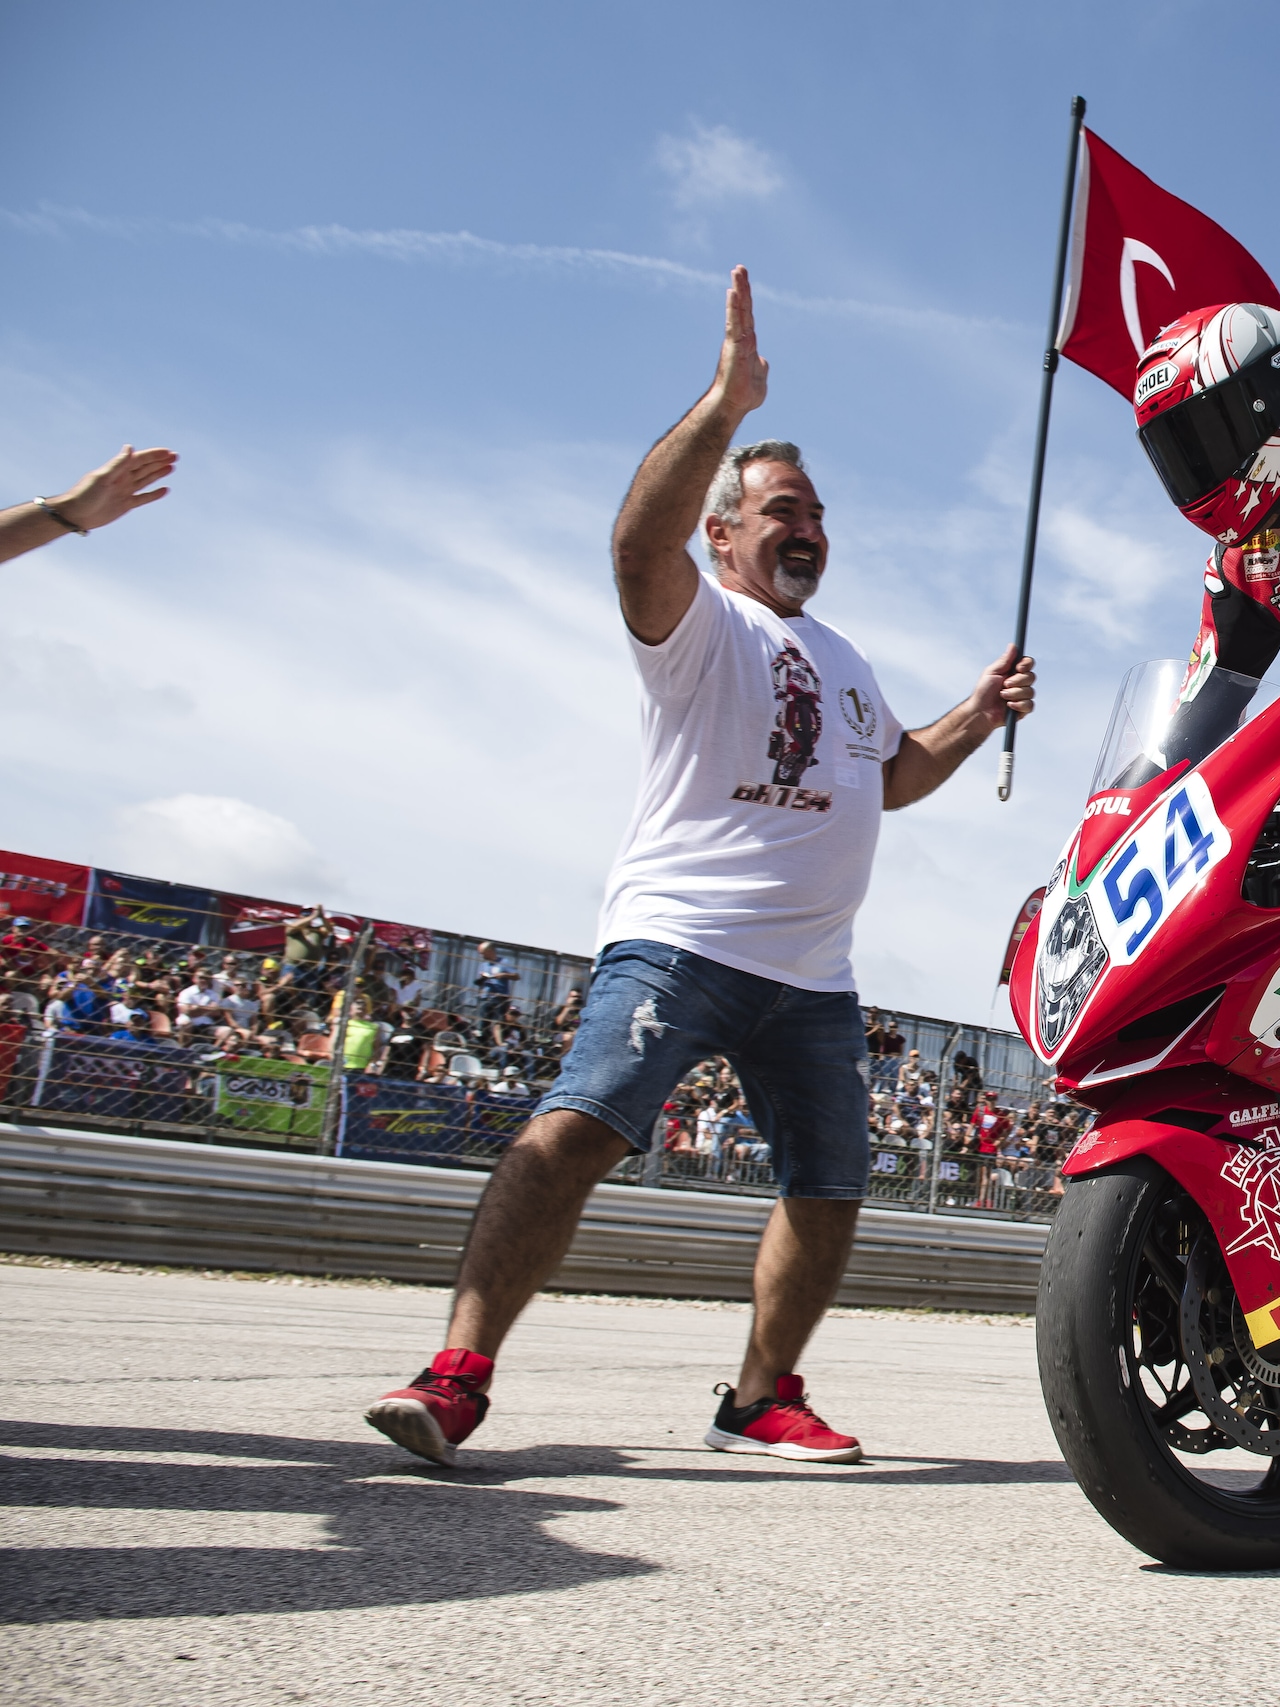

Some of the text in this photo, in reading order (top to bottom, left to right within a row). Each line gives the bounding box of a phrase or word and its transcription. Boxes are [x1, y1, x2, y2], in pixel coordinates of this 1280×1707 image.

[1137, 367, 1169, 399] SHOEI
[1217, 528, 1239, 544] 54
[1083, 796, 1132, 820] OTUL
[1103, 787, 1215, 957] 54
[1231, 1136, 1277, 1178] AGUA
